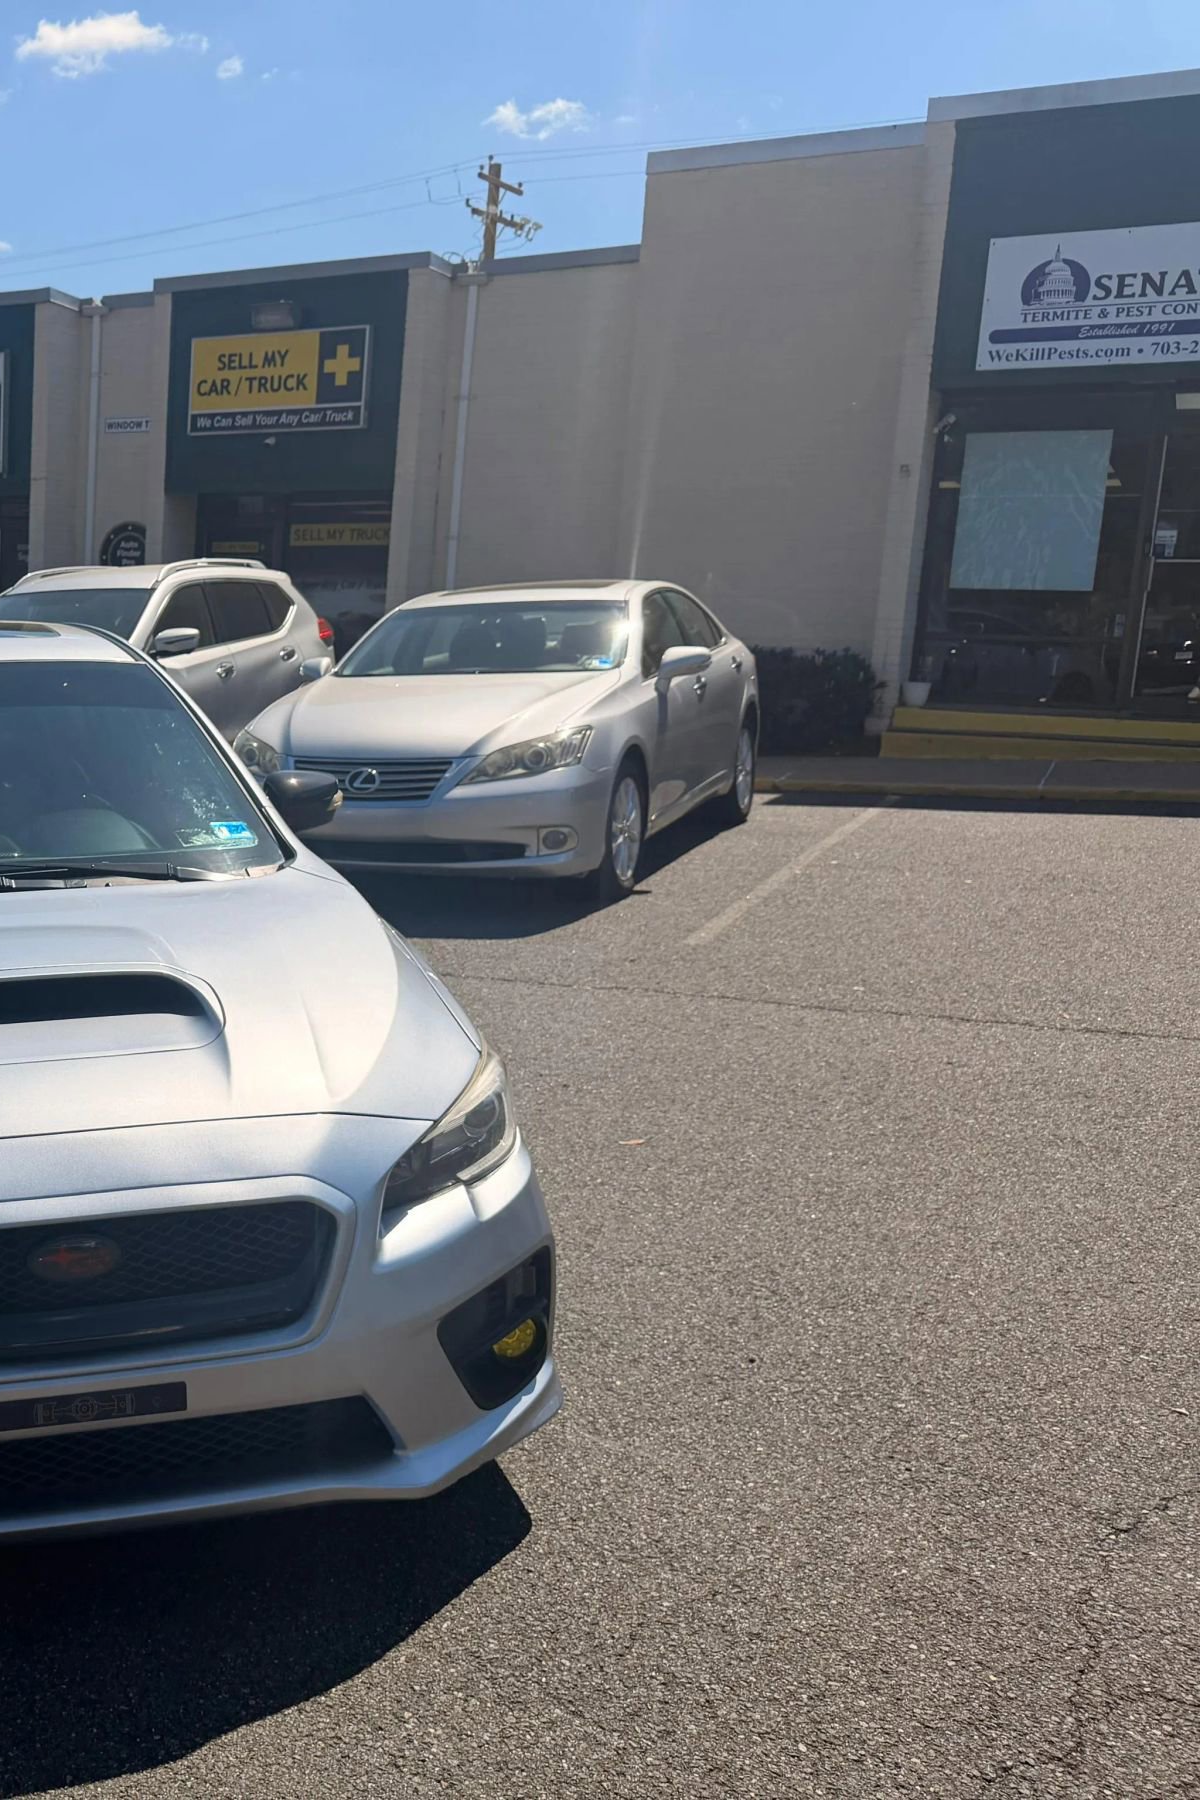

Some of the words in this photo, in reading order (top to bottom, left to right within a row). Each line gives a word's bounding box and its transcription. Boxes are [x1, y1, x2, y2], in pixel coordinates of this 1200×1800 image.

[1092, 269, 1200, 301] SENA
[1020, 308, 1092, 323] TERMITE
[1098, 307, 1110, 319] &
[1115, 304, 1156, 318] PEST
[1161, 303, 1200, 315] CON
[1078, 325, 1138, 338] Established
[1143, 322, 1175, 334] 1991
[217, 352, 258, 371] SELL
[262, 350, 289, 369] MY
[987, 345, 1131, 363] WeKillPests.com
[197, 378, 231, 396] CAR
[245, 373, 308, 394] TRUCK
[106, 420, 143, 430] WINDOW
[197, 416, 212, 428] We
[213, 414, 232, 427] Can
[234, 413, 253, 426] Sell
[255, 413, 278, 425] Your
[279, 412, 300, 426] Any
[325, 409, 354, 422] Truck
[293, 529, 324, 541] SELL
[326, 529, 345, 541] MY
